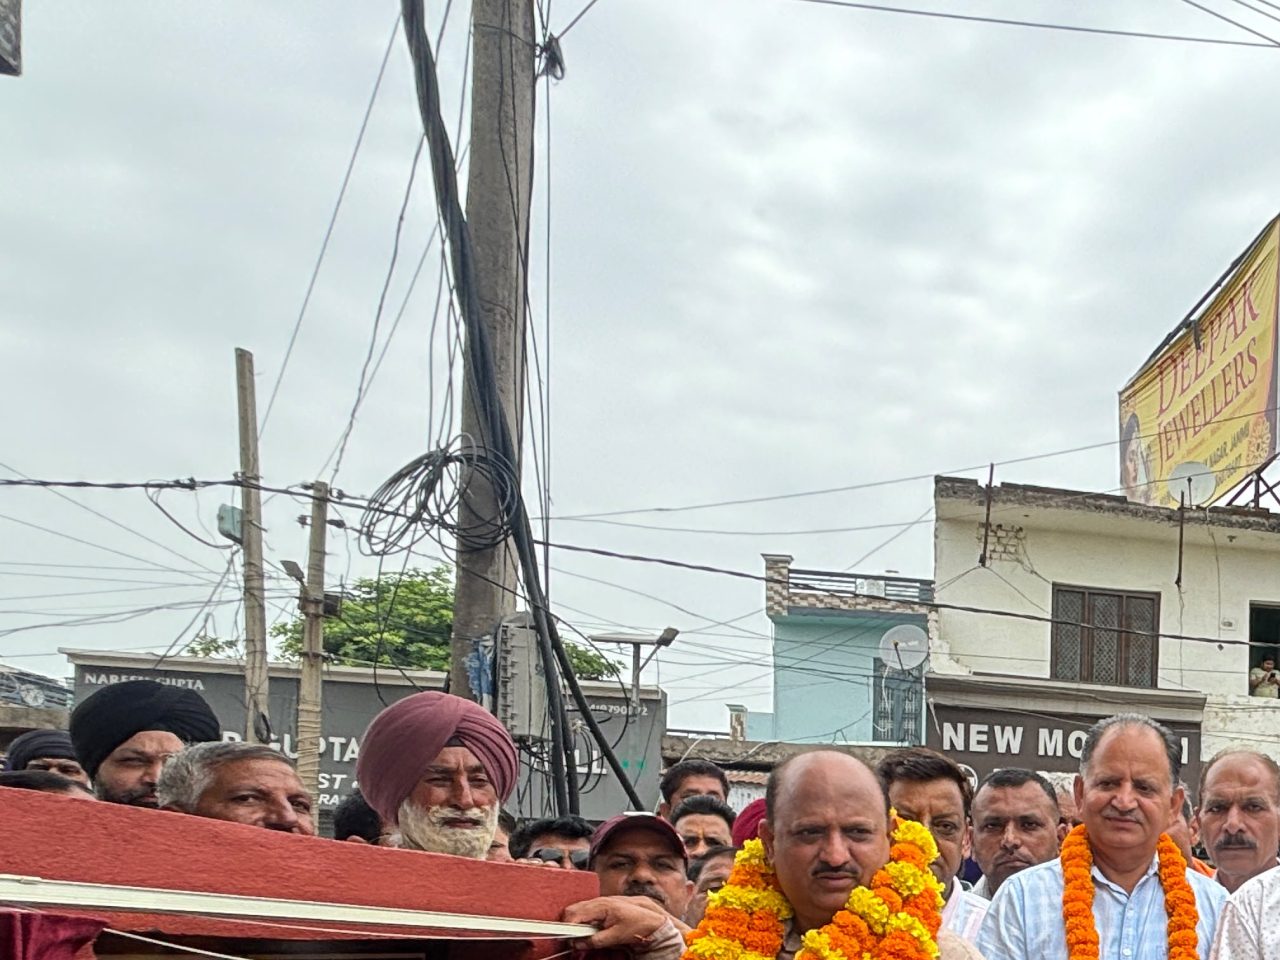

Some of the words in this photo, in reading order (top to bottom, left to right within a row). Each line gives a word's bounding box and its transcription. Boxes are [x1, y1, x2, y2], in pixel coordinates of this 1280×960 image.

[1156, 272, 1259, 417] DEEPAK
[1157, 336, 1258, 477] JEWELLERS
[943, 722, 1023, 754] NEW
